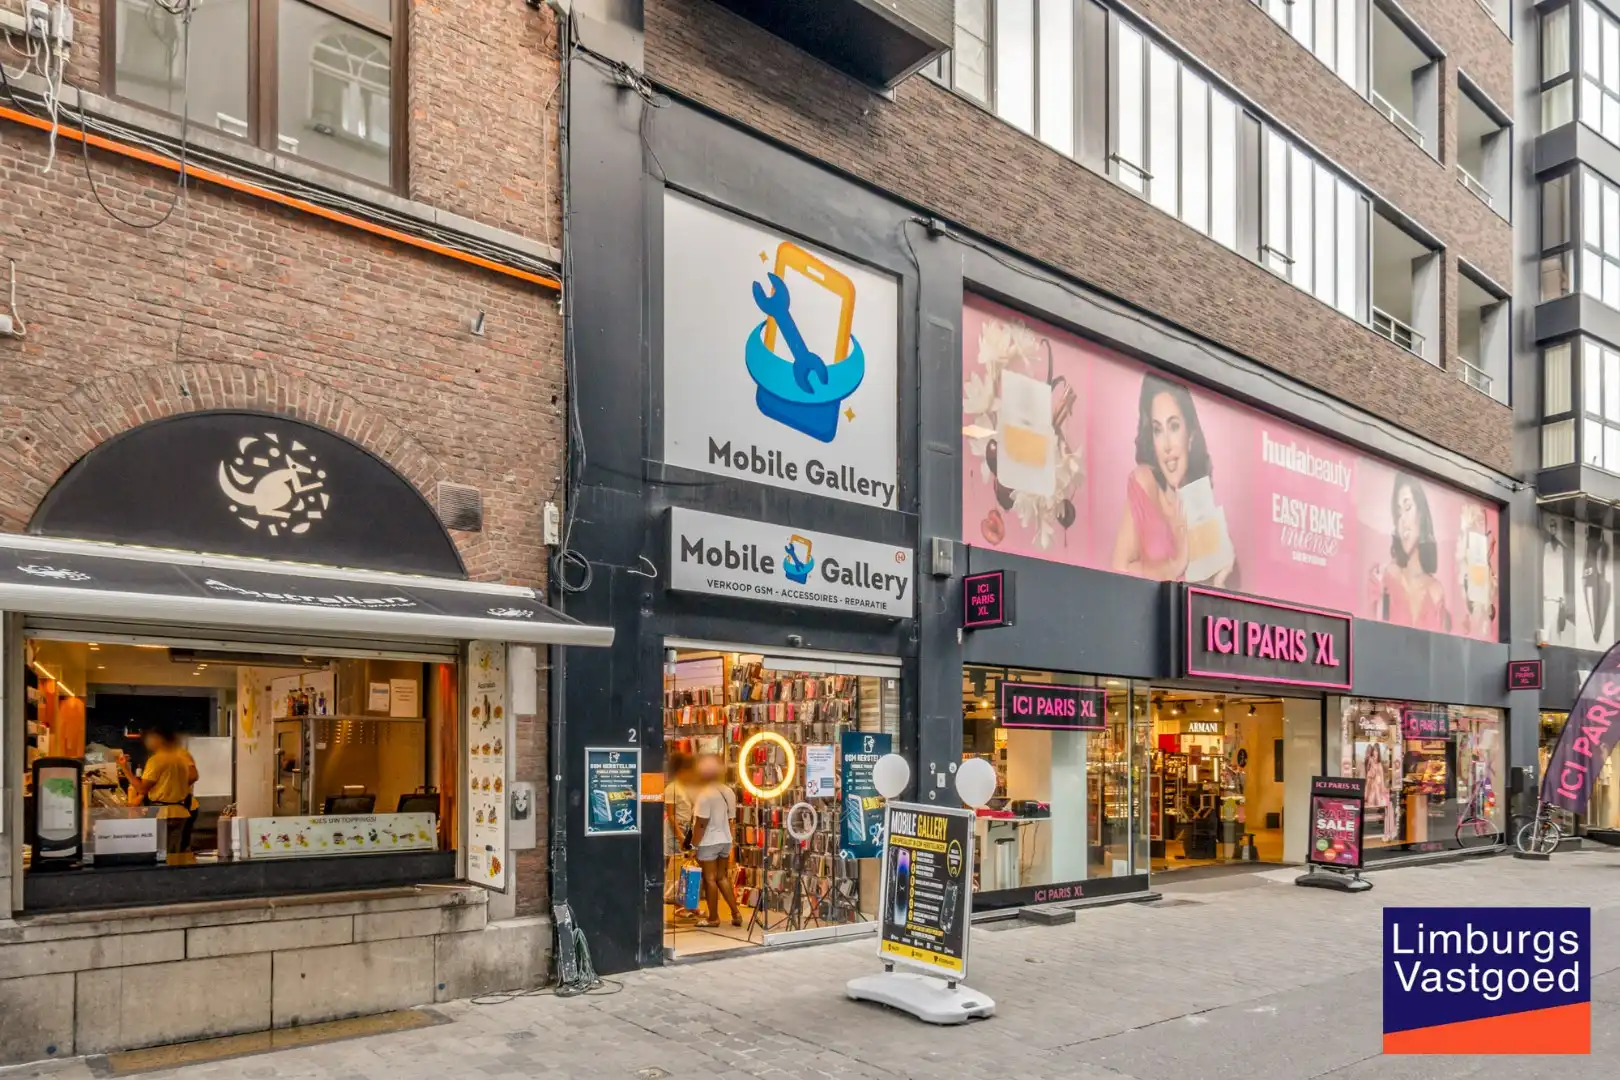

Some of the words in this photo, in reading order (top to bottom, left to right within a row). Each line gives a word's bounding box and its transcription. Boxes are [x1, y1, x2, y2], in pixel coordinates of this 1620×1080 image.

[708, 436, 798, 482] Mobile
[805, 459, 895, 507] Gallery
[1262, 430, 1352, 493] hudabeauty
[1272, 492, 1308, 531] EASY
[1309, 504, 1344, 540] BAKE
[681, 534, 775, 574] Mobile
[821, 557, 908, 601] Gallery
[707, 578, 752, 592] VERKOOP
[754, 585, 773, 596] GSM
[781, 589, 838, 604] ACCESSOIRES
[844, 597, 887, 610] REPARATIE
[971, 593, 995, 606] PARIS
[977, 583, 989, 594] ICI
[977, 606, 989, 616] XL
[1206, 615, 1239, 654] ICI
[1247, 621, 1308, 663] PARIS
[1315, 631, 1340, 667] XL
[1013, 695, 1032, 714] ICI
[1037, 696, 1076, 716] PARIS
[1080, 699, 1097, 718] XL
[1572, 681, 1620, 757] PARIS
[628, 728, 637, 742] 2
[1189, 722, 1218, 733] ARMANI
[1557, 760, 1588, 800] ICI
[890, 810, 917, 836] MOBILE
[917, 815, 948, 840] GALLERY
[1317, 819, 1355, 832] SALE
[1034, 890, 1047, 902] ICI
[1048, 887, 1071, 899] PARIS
[1074, 885, 1084, 897] XL
